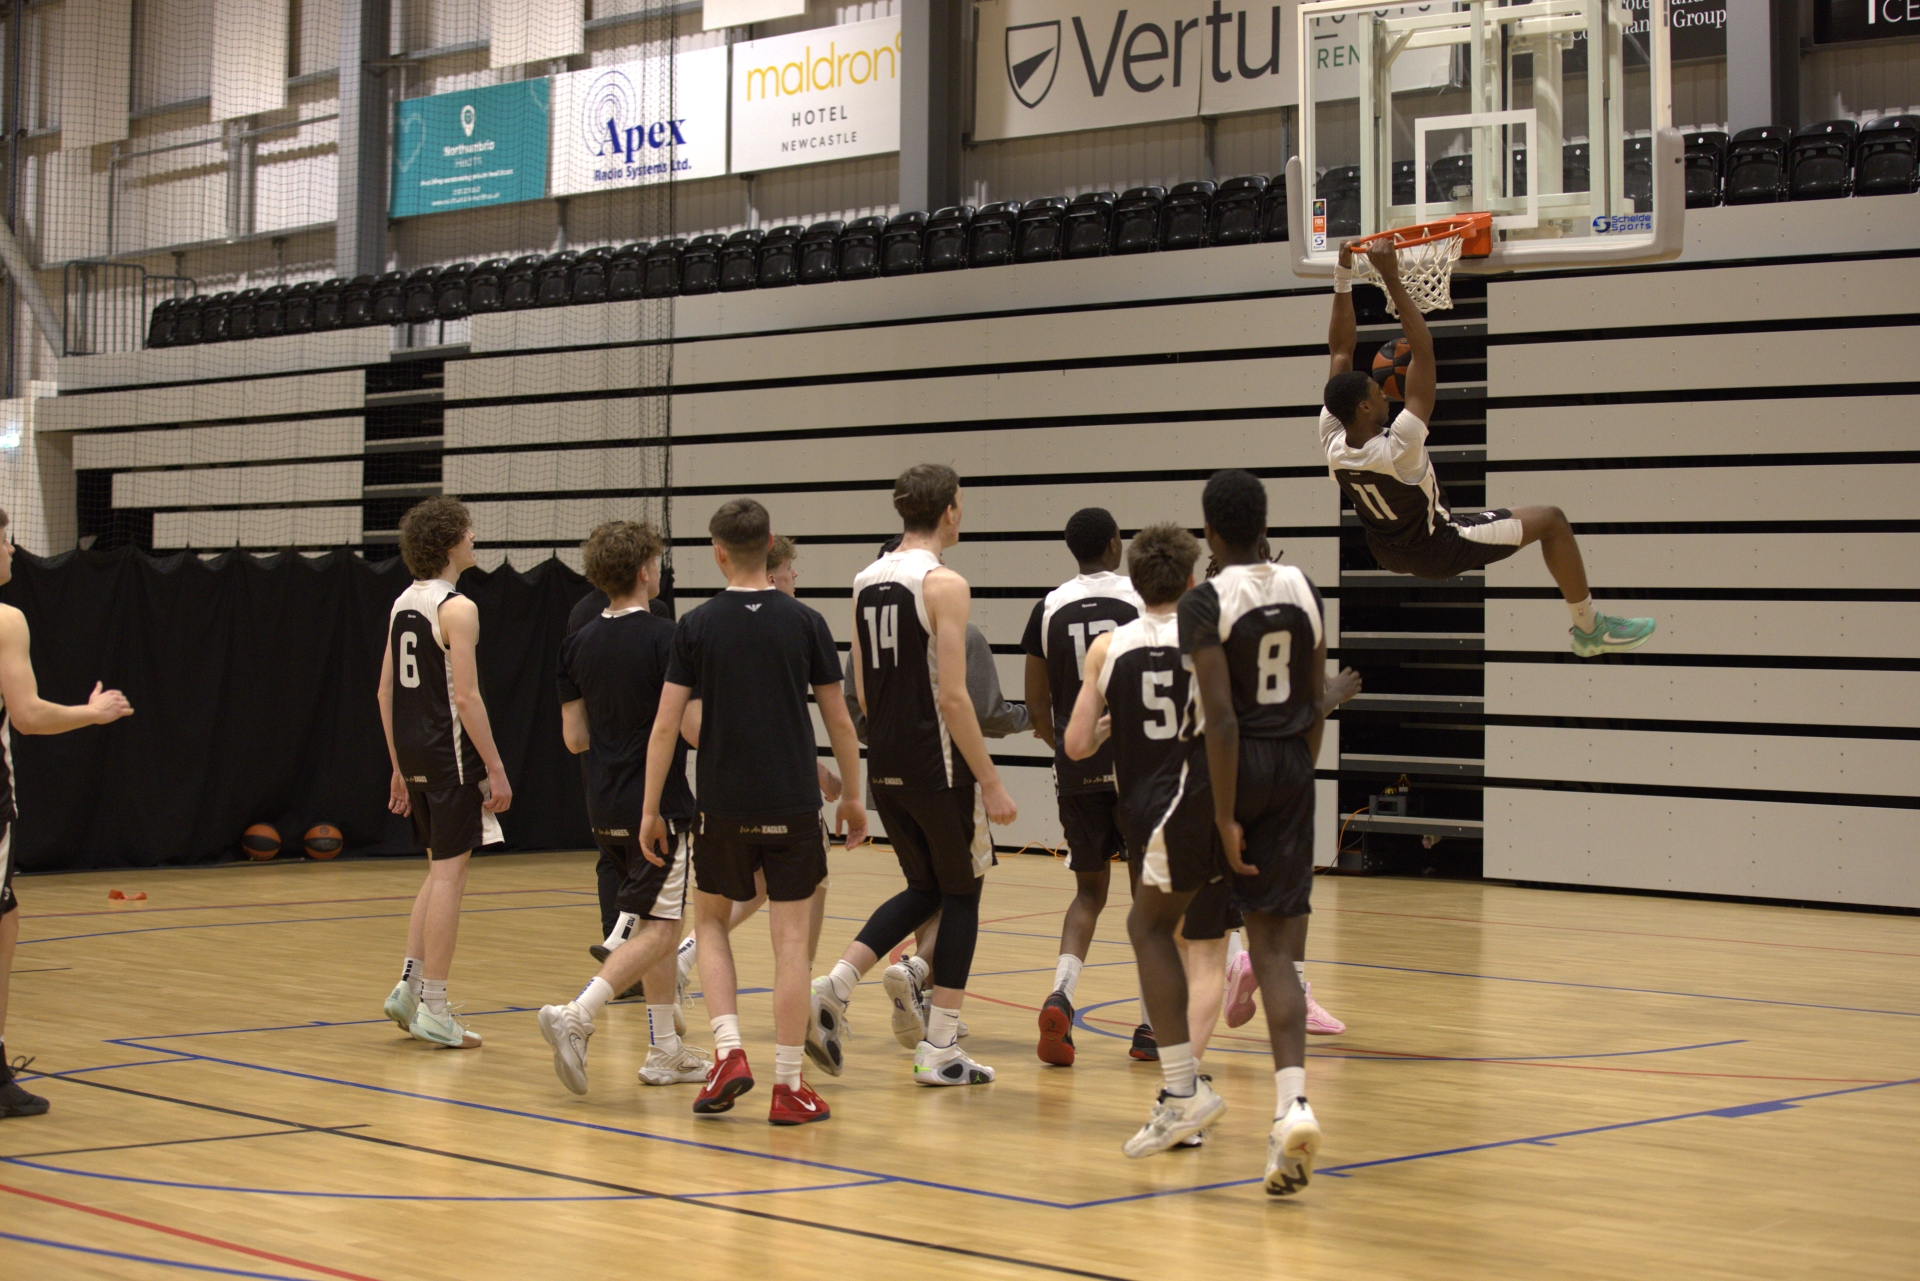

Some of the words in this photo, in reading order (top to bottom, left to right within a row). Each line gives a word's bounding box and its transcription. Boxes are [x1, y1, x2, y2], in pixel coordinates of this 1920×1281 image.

[1673, 9, 1727, 29] Group
[1072, 0, 1280, 97] Vertu
[1317, 45, 1360, 69] REN
[747, 41, 895, 102] maldron
[792, 105, 848, 127] HOTEL
[596, 117, 687, 164] Apex
[781, 131, 858, 152] NEWCASTLE
[594, 167, 623, 181] Radio
[626, 162, 668, 180] Systems
[670, 158, 692, 172] Ltd.
[1611, 222, 1651, 233] Sports
[1350, 482, 1399, 520] 11
[863, 604, 899, 669] 14
[400, 631, 420, 689] 6
[1257, 630, 1292, 705] 8
[1142, 670, 1178, 740] 5
[761, 824, 789, 835] EAGLES
